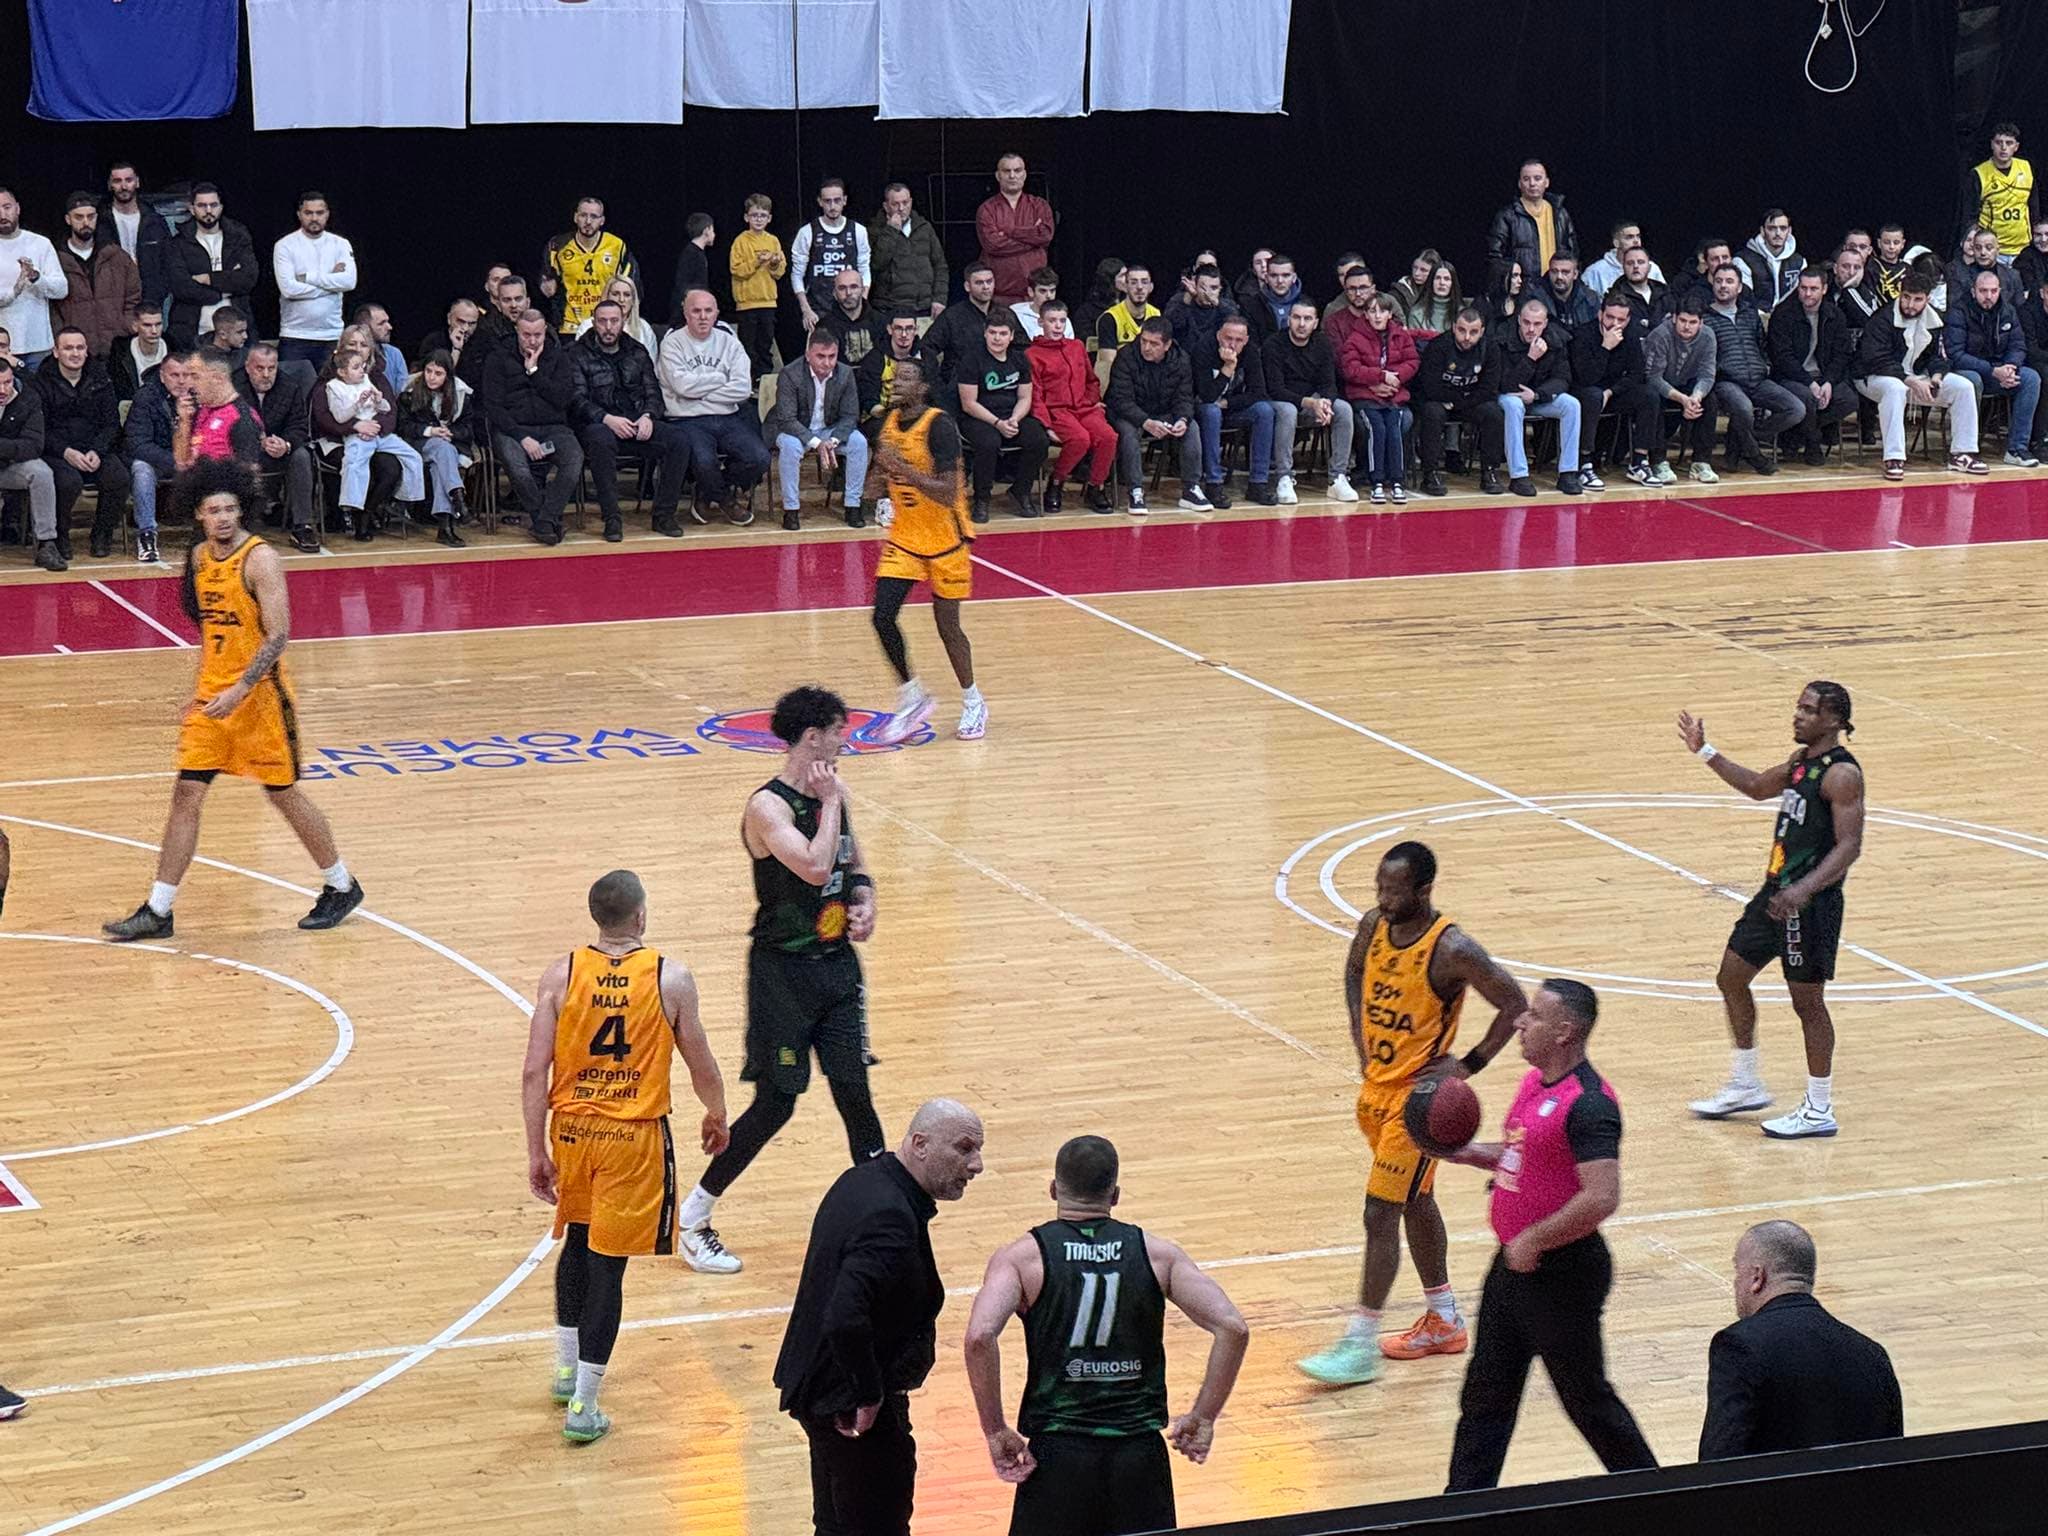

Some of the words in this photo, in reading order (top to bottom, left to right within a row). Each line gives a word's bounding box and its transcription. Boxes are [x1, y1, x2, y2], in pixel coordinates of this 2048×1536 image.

[2003, 208, 2020, 221] 03
[823, 252, 846, 264] go+
[584, 259, 593, 276] 4
[211, 634, 225, 655] 7
[317, 727, 680, 761] WOMEN
[596, 972, 629, 989] vita
[592, 994, 629, 1008] MALA
[589, 1015, 632, 1062] 4
[577, 1067, 641, 1085] gorenje
[1069, 1271, 1120, 1347] 11
[1083, 1359, 1142, 1374] EUROSIG
